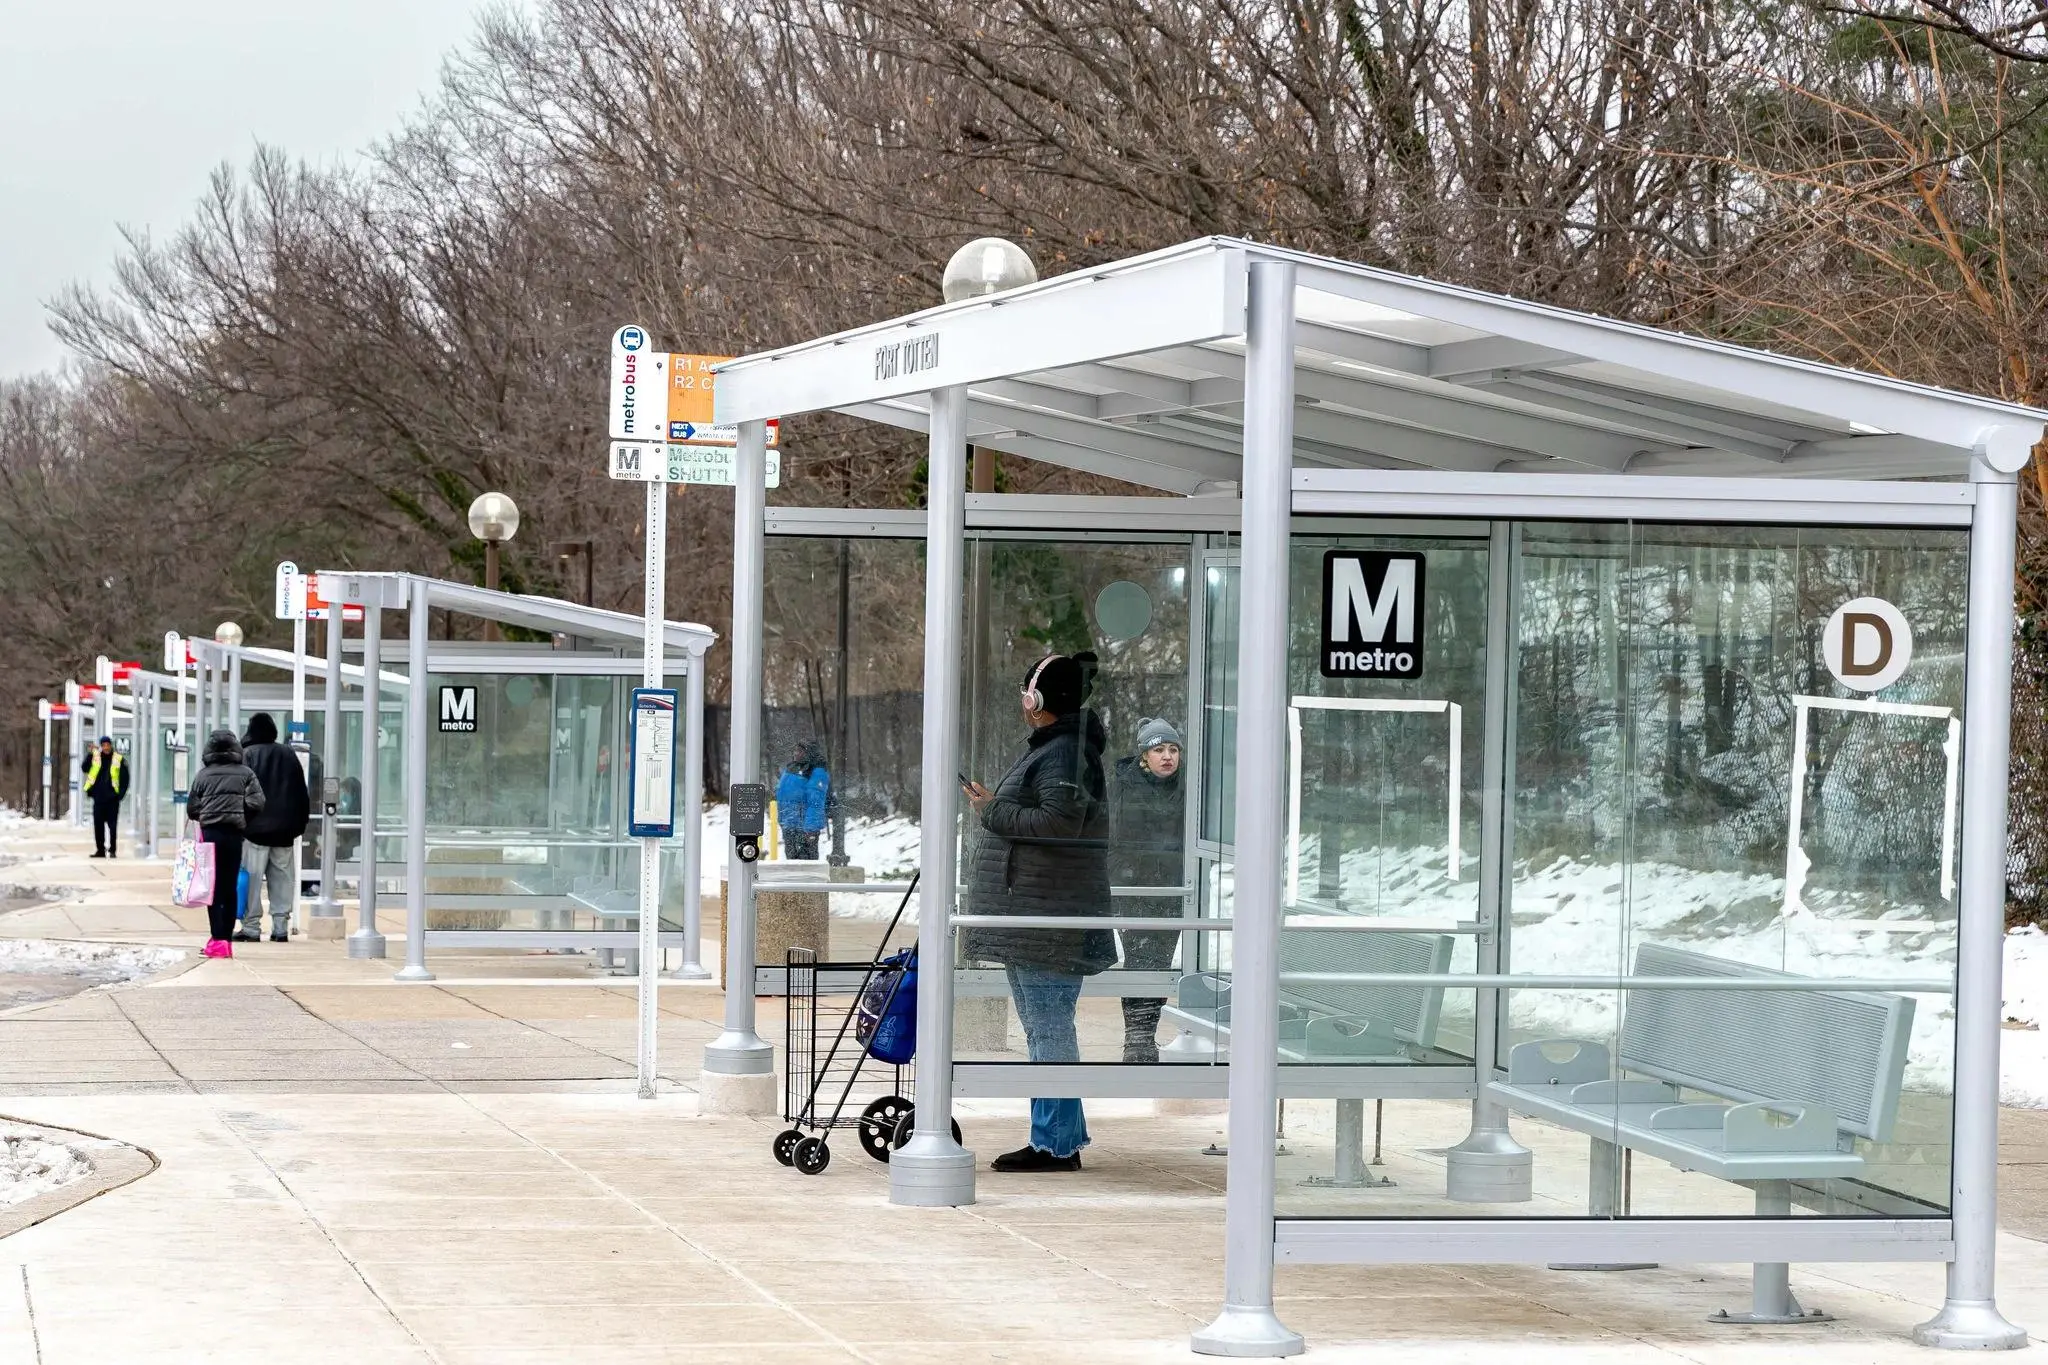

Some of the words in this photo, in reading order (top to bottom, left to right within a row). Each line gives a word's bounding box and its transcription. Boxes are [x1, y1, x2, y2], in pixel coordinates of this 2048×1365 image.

[675, 358, 692, 371] R1
[875, 343, 900, 380] FORT
[903, 332, 939, 374] TOTTEN
[622, 354, 636, 433] metrobus
[674, 375, 695, 388] R2
[618, 449, 640, 470] M
[1331, 557, 1416, 643] M
[1840, 612, 1893, 676] D
[1330, 648, 1414, 672] metro
[442, 688, 475, 720] M
[441, 721, 475, 730] metro
